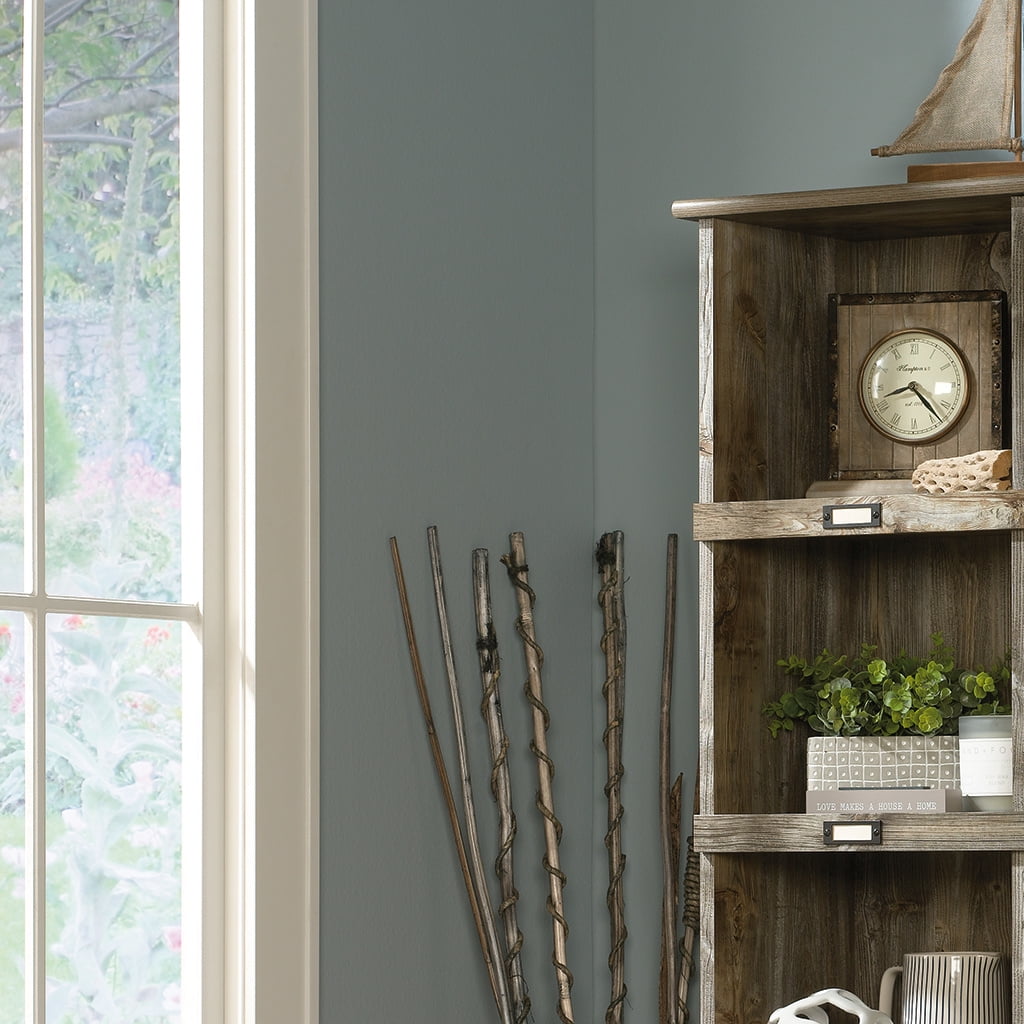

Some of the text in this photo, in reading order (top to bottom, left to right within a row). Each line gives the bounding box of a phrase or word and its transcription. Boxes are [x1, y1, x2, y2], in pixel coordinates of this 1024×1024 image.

[816, 801, 937, 811] LOVE MAKES A HOUSE A HOME
